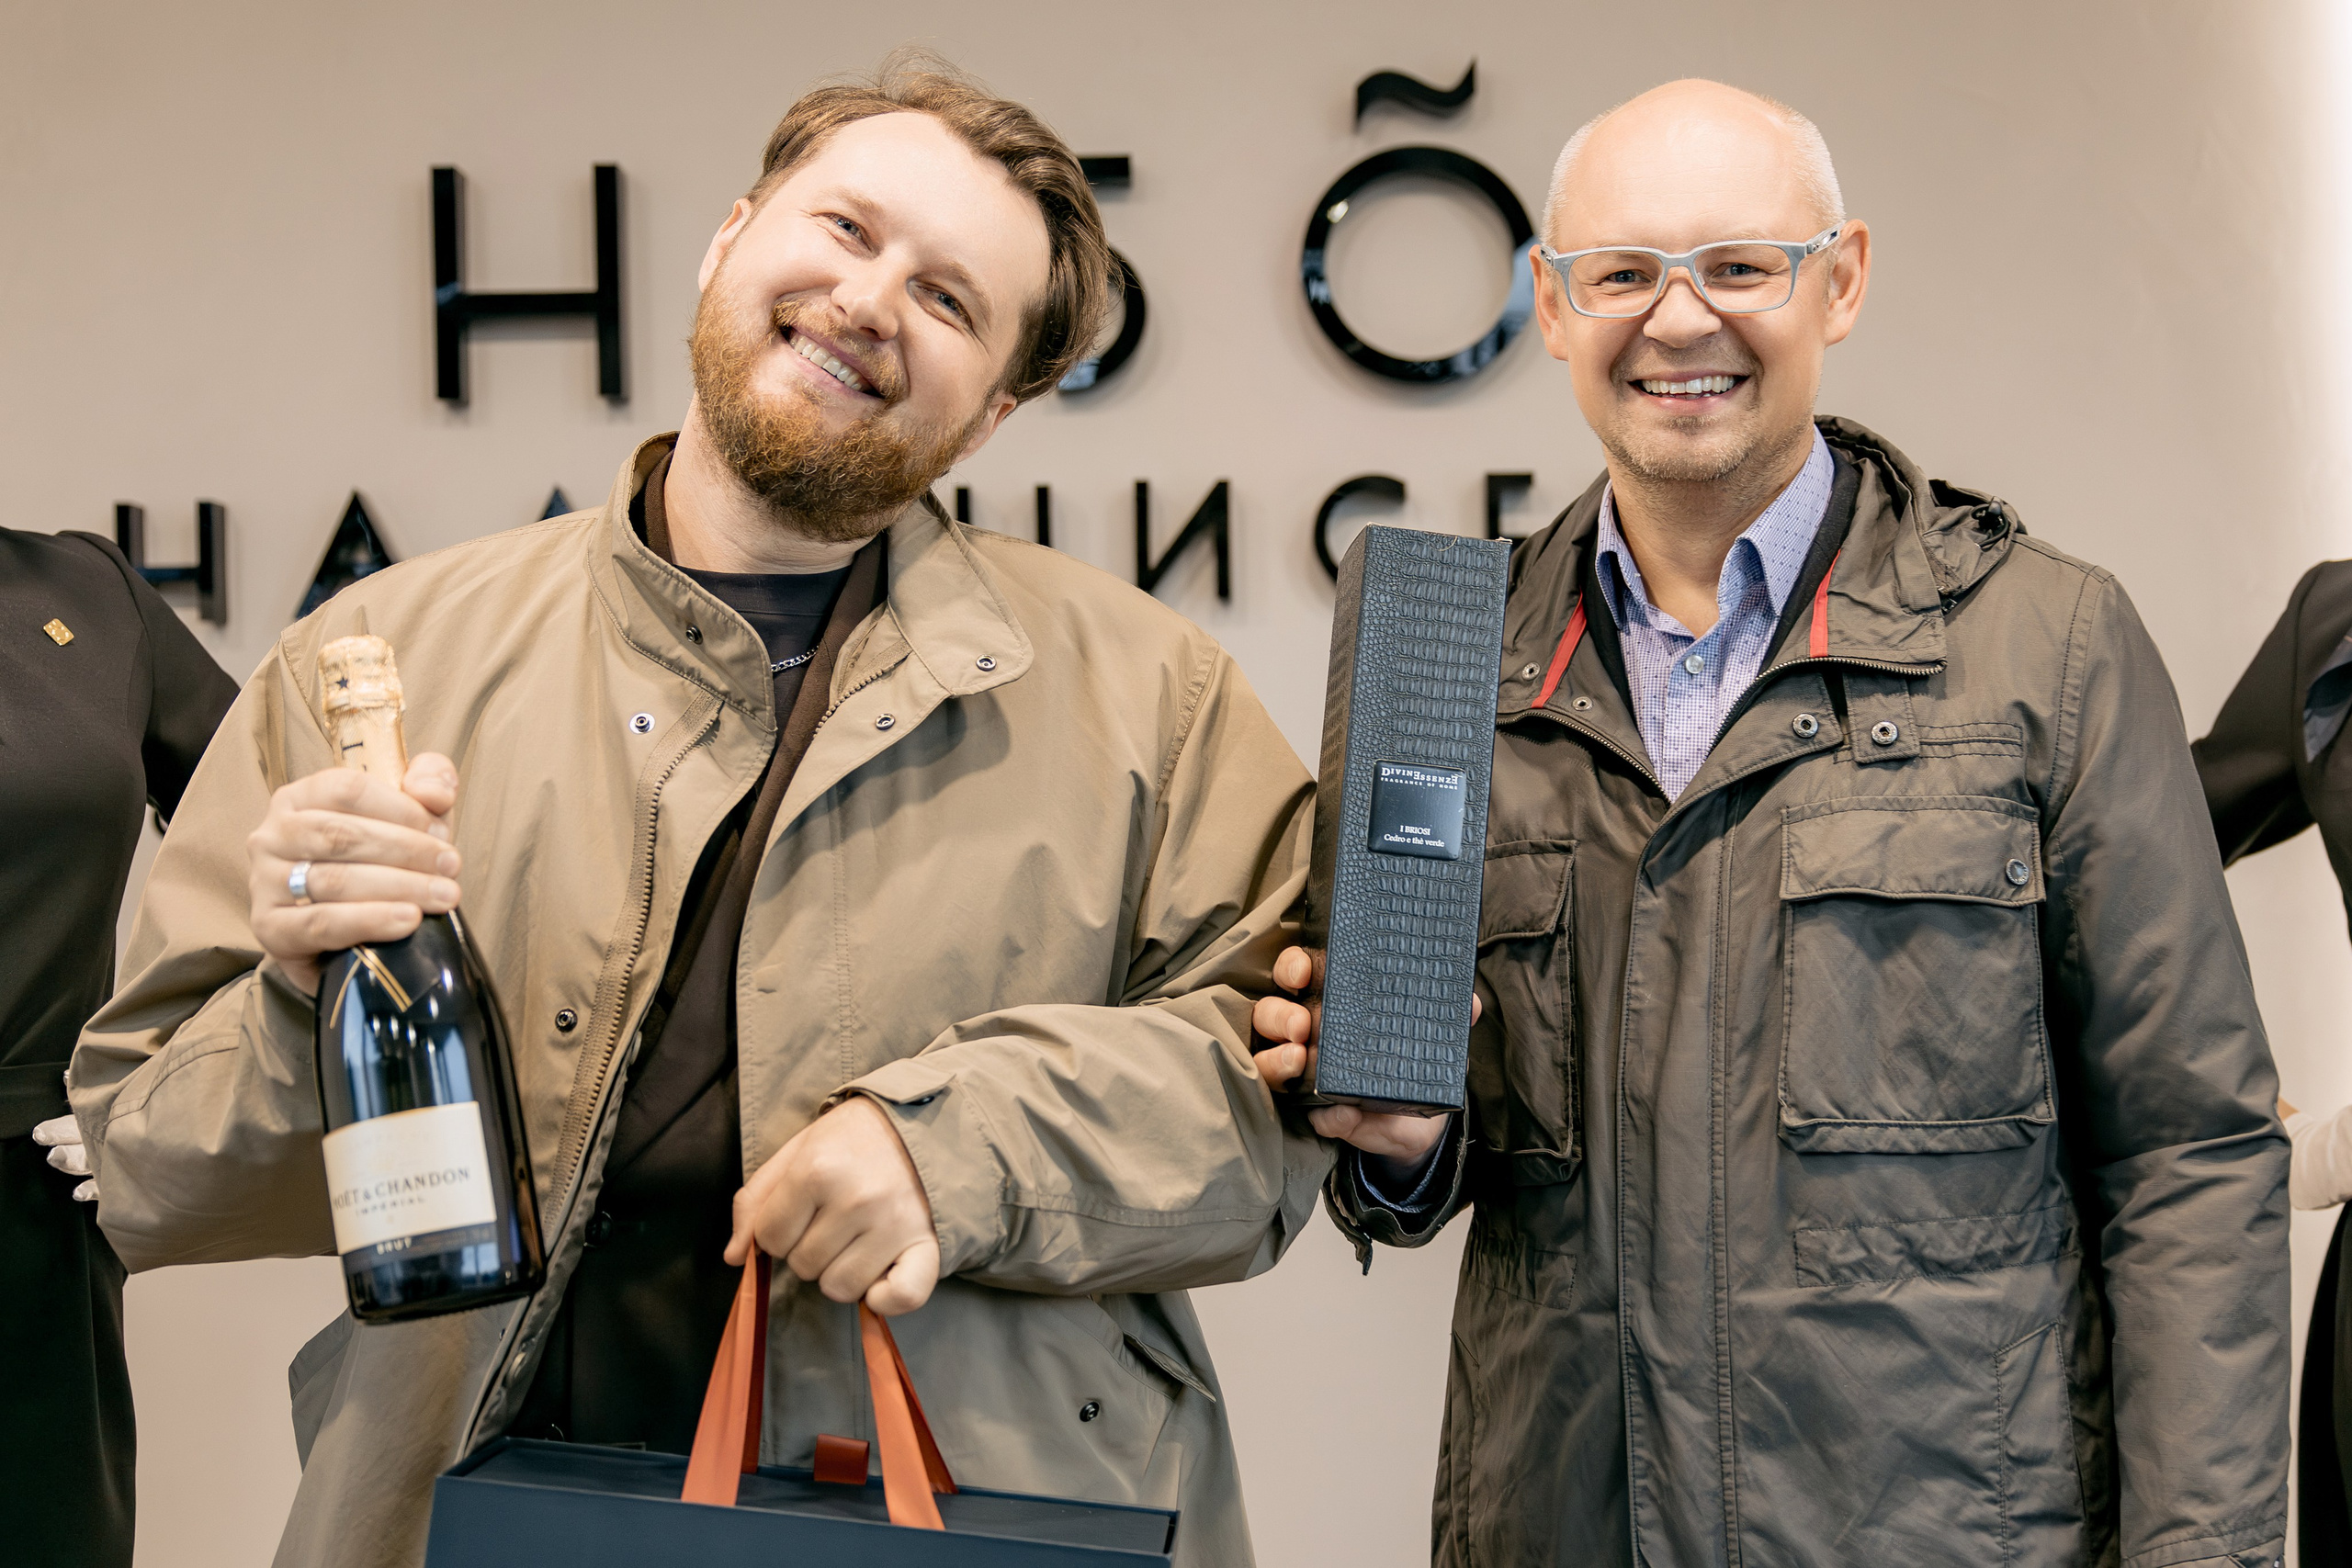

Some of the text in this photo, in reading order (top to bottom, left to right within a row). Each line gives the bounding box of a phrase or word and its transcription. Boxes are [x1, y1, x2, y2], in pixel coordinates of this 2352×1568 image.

[1381, 777, 1423, 785] FRAGRANCE
[1405, 825, 1431, 836] BRIOSI
[1384, 833, 1406, 843] Cedro
[1424, 839, 1445, 847] verde
[375, 1168, 469, 1197] CHANDON
[377, 1237, 412, 1255] BRUT
